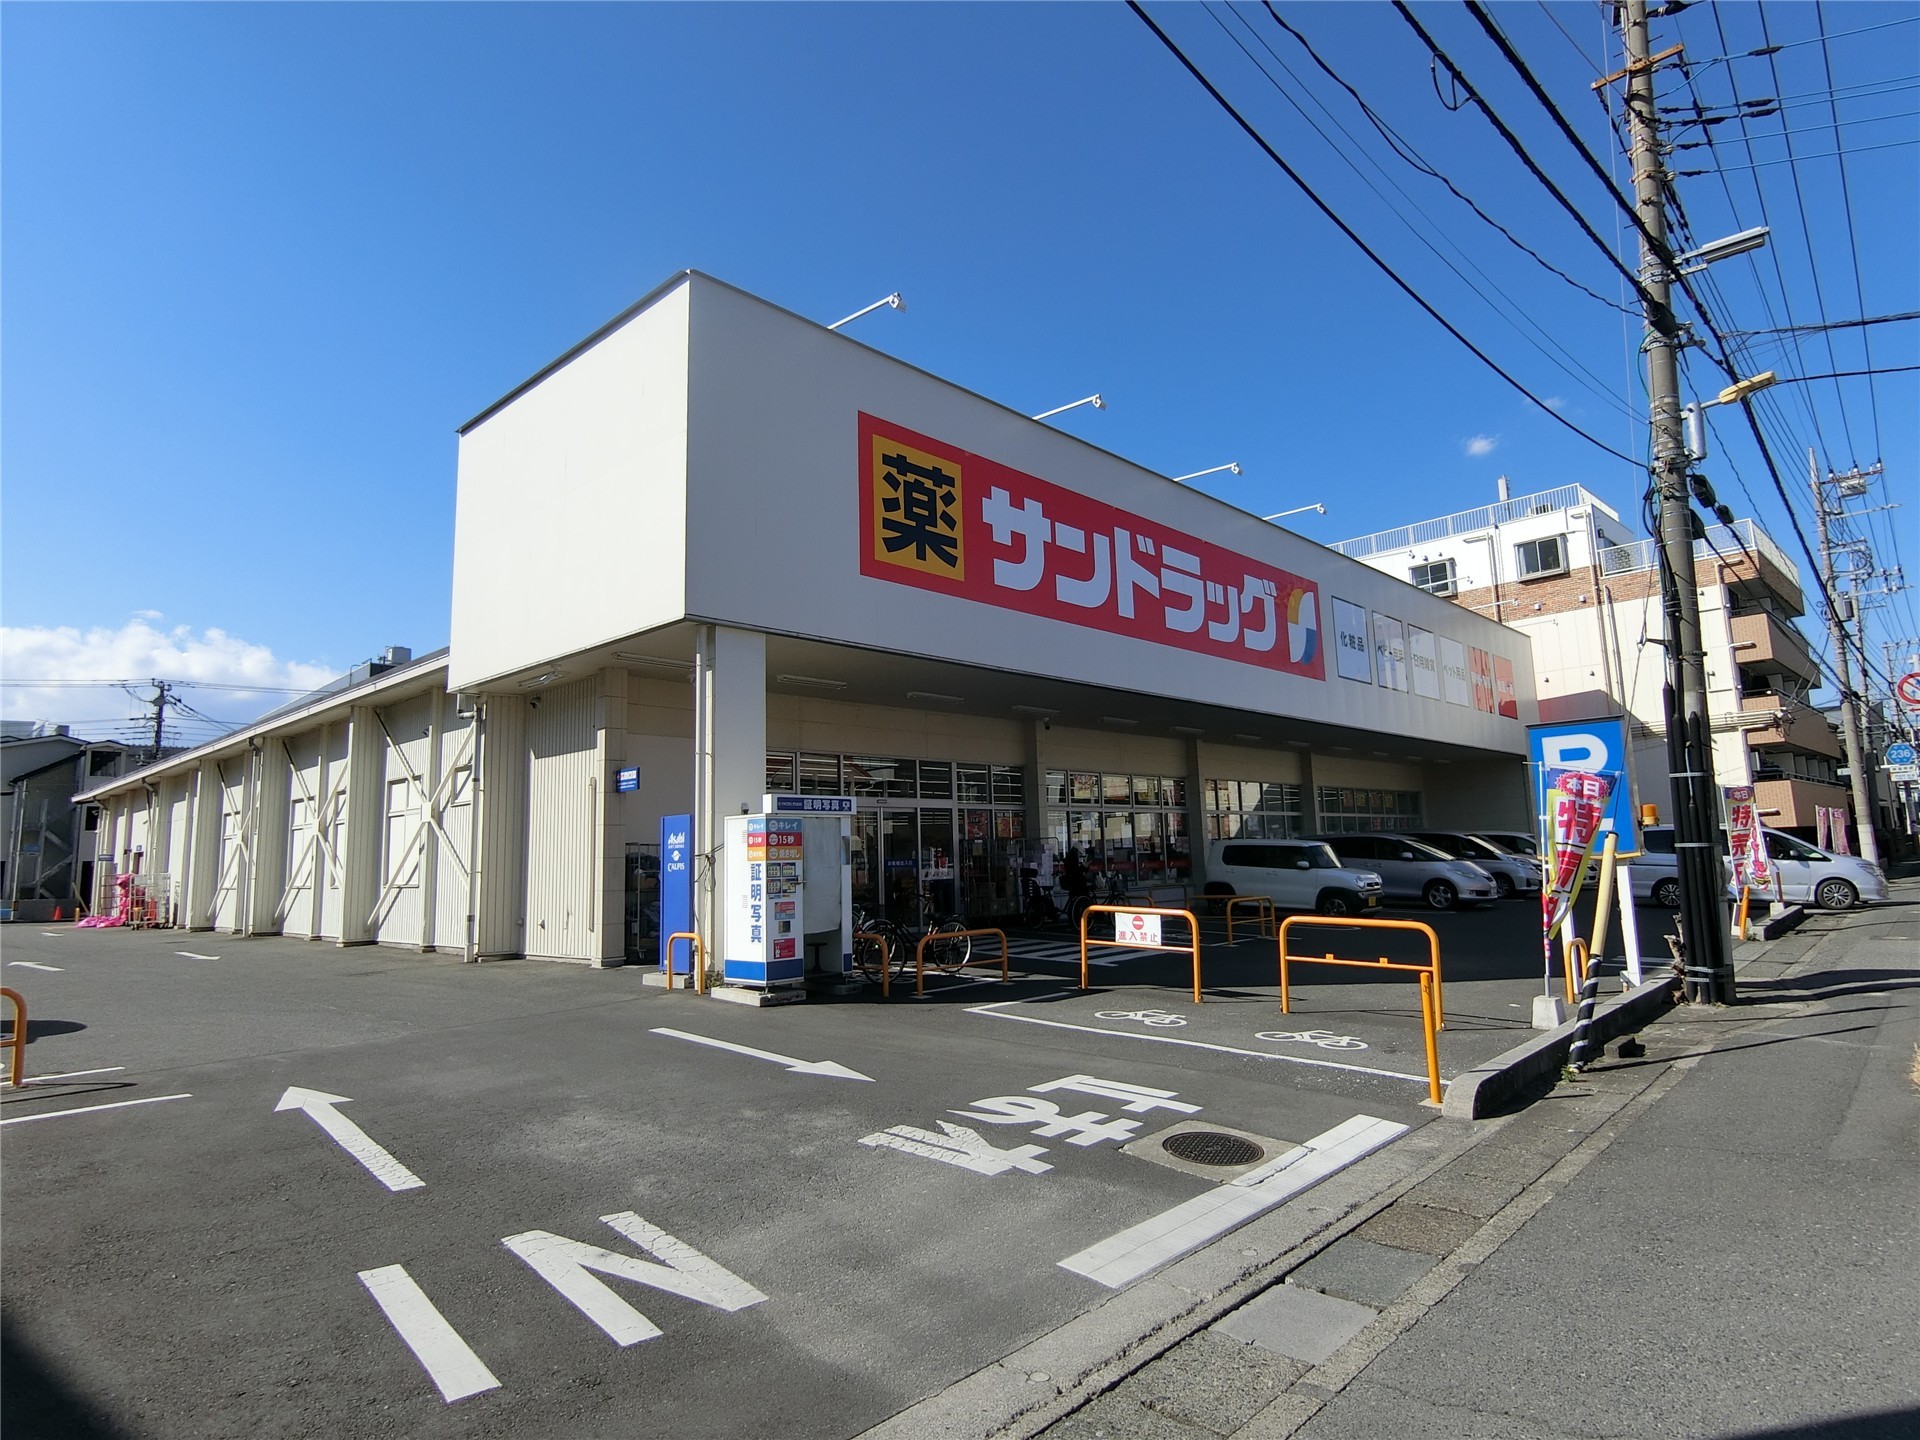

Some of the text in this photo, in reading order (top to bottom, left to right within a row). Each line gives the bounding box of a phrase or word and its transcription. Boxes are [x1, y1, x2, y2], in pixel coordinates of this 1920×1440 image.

[881, 452, 959, 568] 薬
[981, 485, 1277, 652] サンドラッグ
[1339, 630, 1365, 653] 化粧品
[1890, 749, 1911, 759] 236
[1566, 776, 1601, 797] 本日
[803, 798, 840, 811] 証明写真
[779, 821, 798, 829] キレイ
[668, 832, 685, 844] Asahi
[778, 835, 795, 844] 15秒
[750, 863, 762, 943] 証明写真
[1118, 930, 1159, 943] 進入禁止
[857, 1074, 1204, 1176] 止まれ
[356, 1210, 769, 1404] IN
